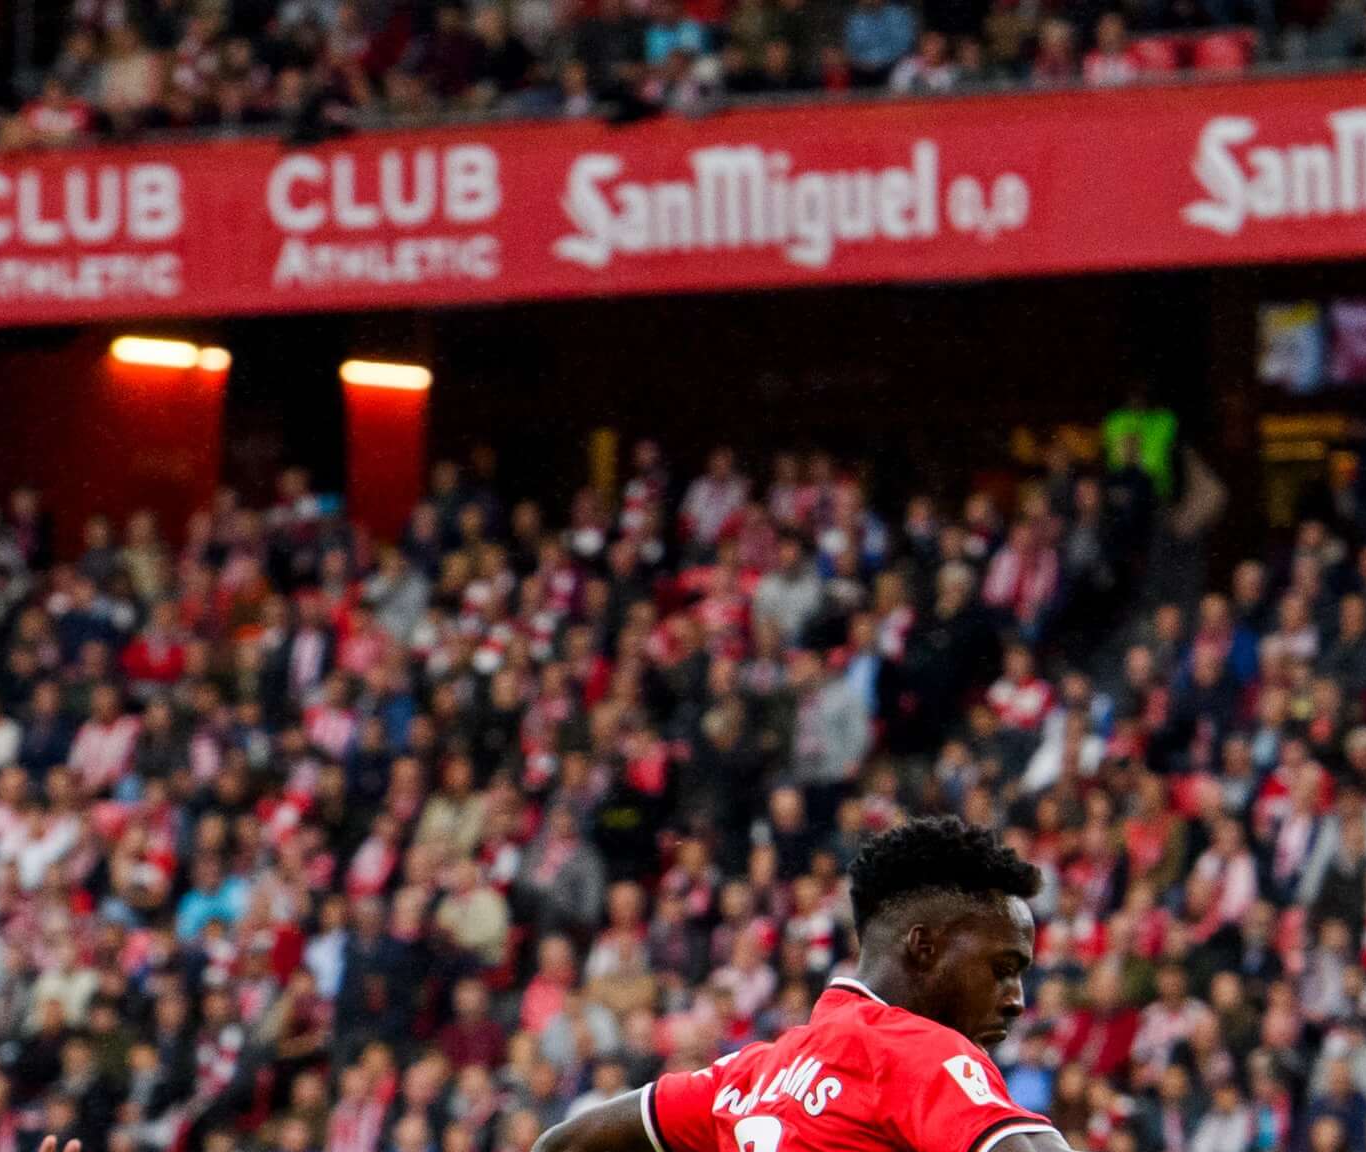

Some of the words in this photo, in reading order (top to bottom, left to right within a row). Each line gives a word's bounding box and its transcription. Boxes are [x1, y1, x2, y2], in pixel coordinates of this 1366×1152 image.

[267, 144, 501, 230] CLUB
[554, 139, 938, 268] SanMiguel
[273, 232, 501, 288] ATHLETIC
